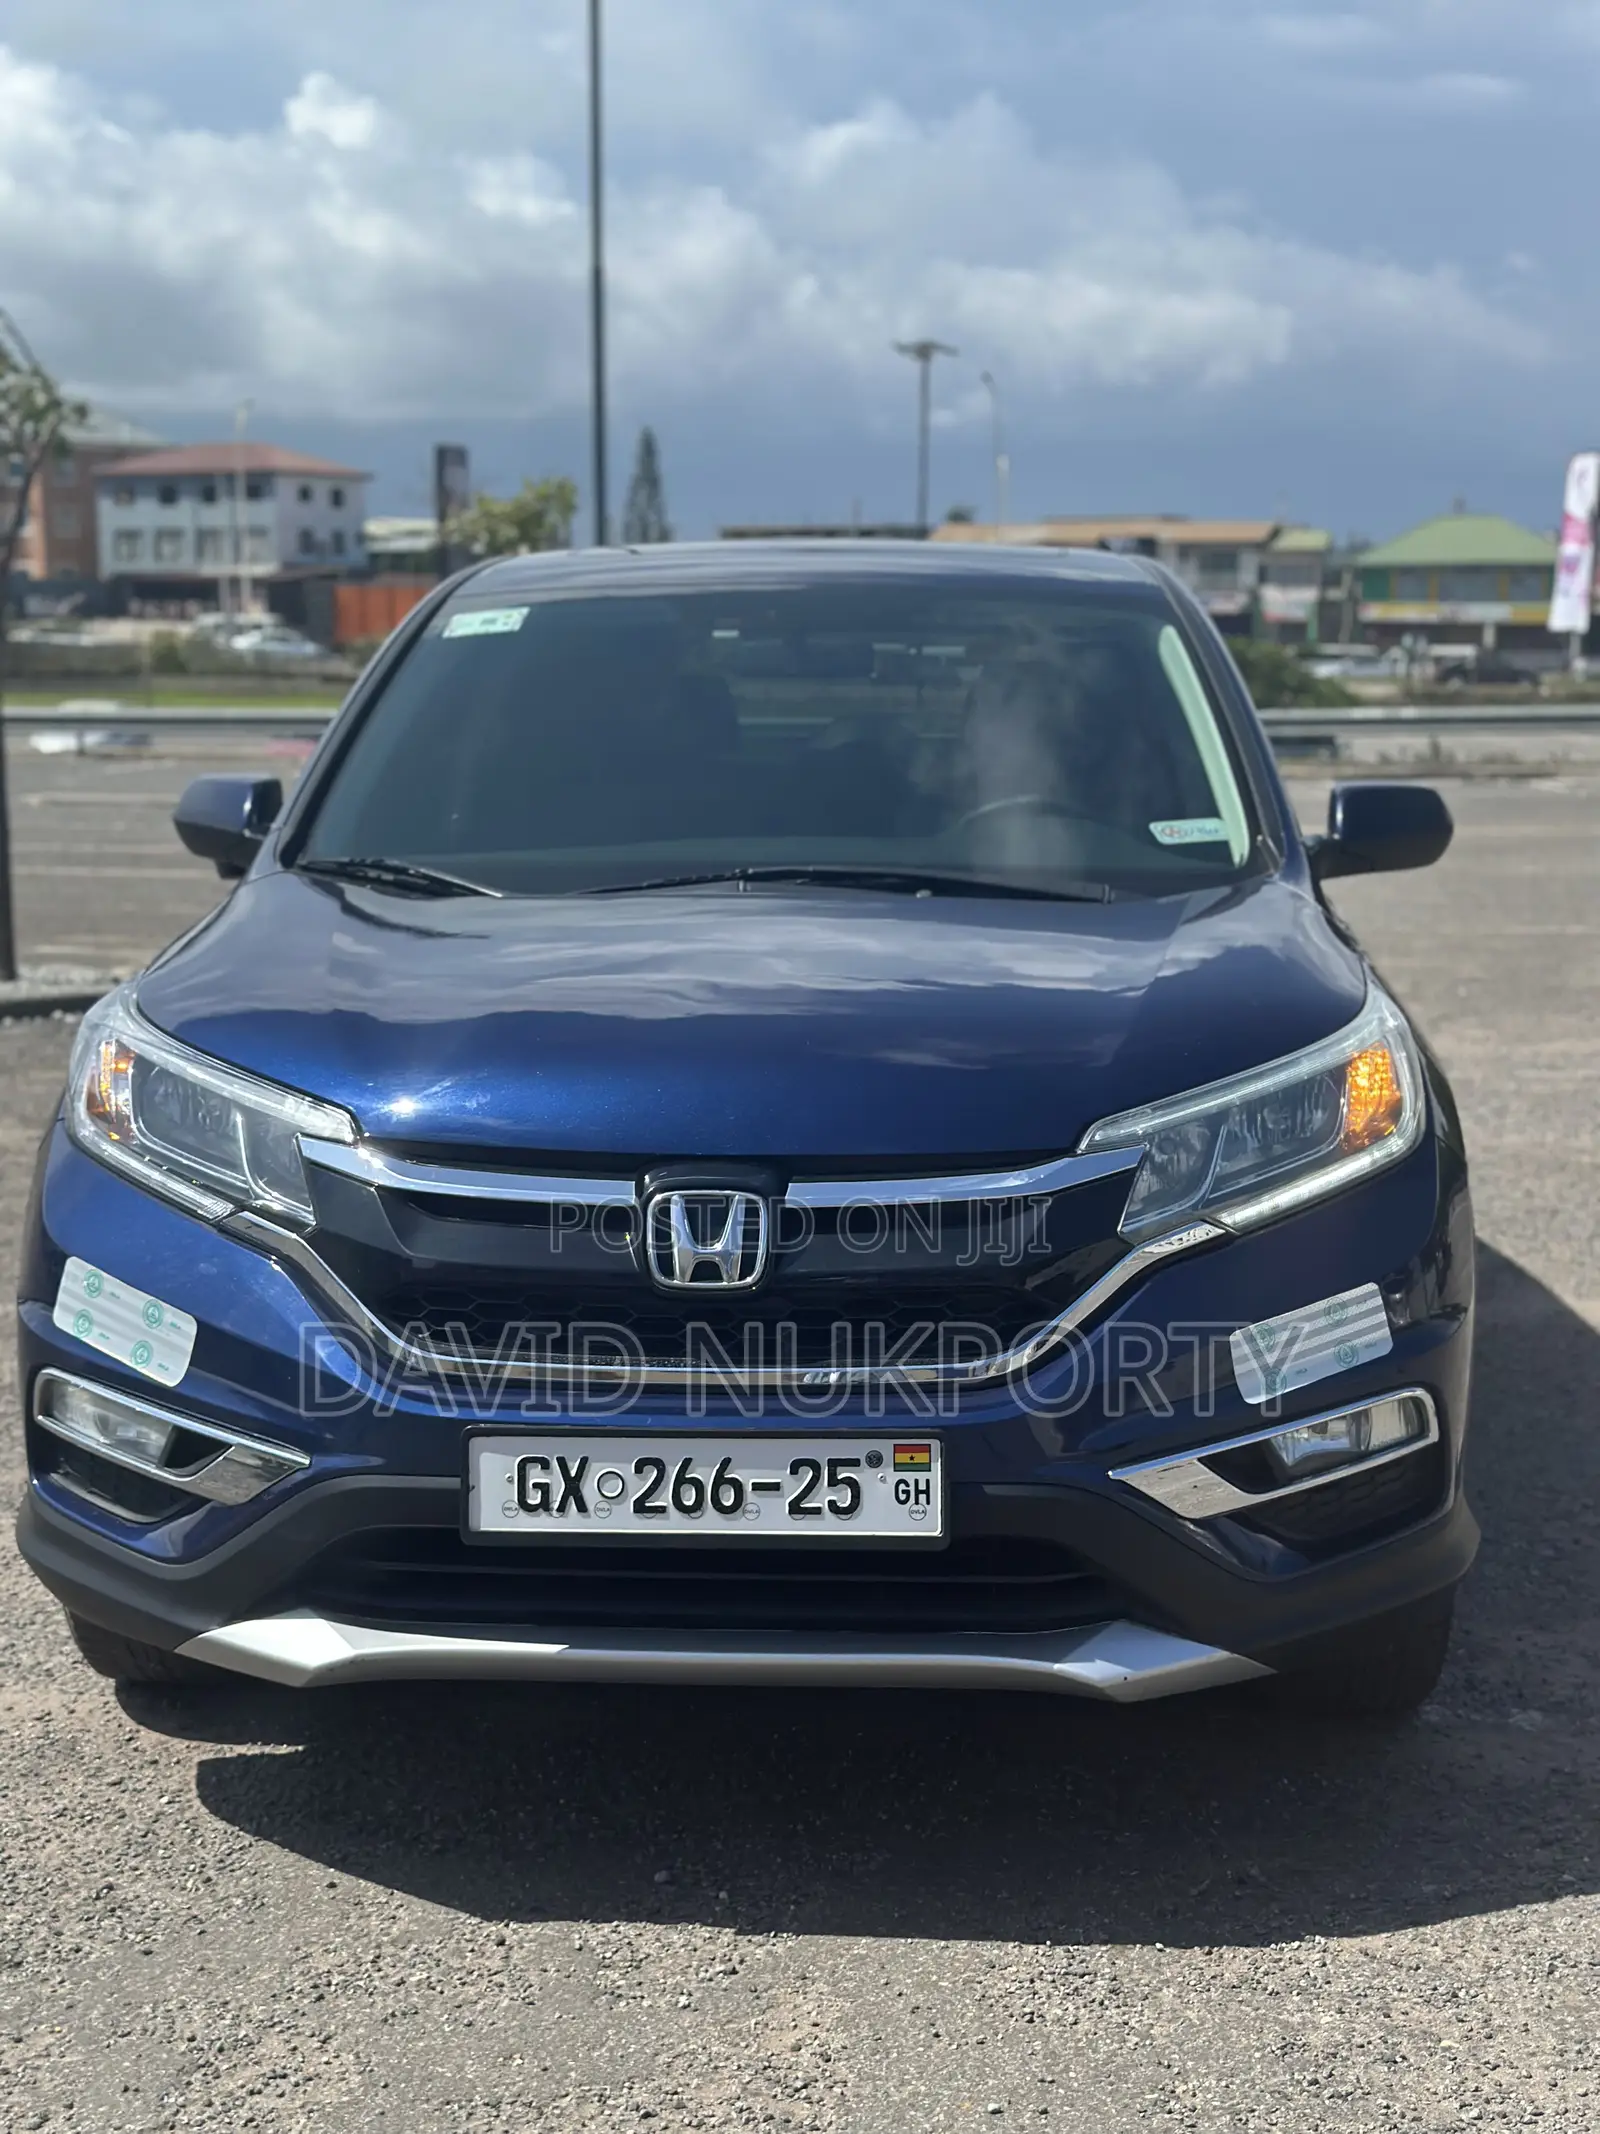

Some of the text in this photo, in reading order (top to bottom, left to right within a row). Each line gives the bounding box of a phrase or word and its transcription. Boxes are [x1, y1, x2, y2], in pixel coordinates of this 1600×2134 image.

[515, 1455, 862, 1516] GX 266-25
[893, 1477, 931, 1506] GH
